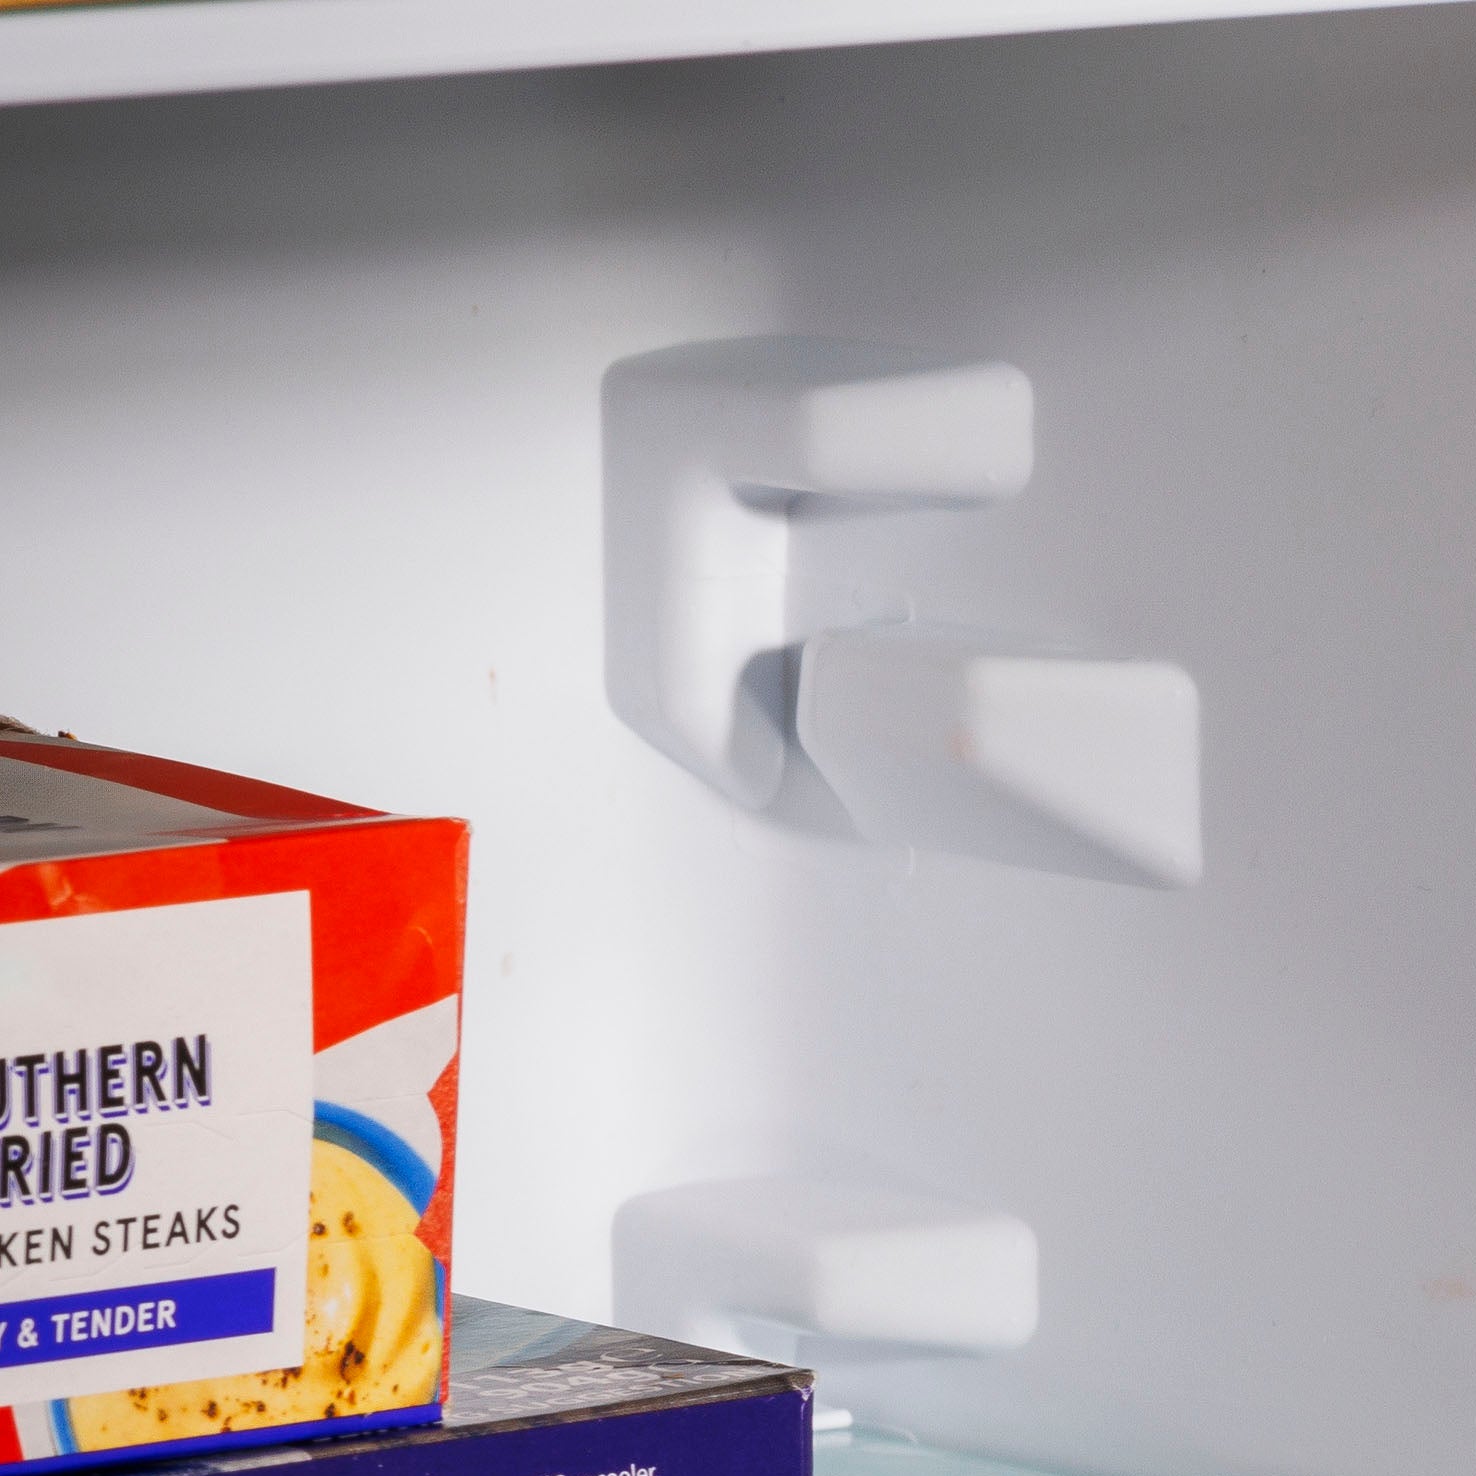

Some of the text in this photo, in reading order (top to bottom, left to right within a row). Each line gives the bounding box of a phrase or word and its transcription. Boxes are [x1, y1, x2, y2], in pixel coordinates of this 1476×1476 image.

[0, 1034, 212, 1131] THERN
[0, 1123, 136, 1208] RIED
[92, 1204, 240, 1256] STEAKS
[17, 1300, 176, 1348] & TENDER
[486, 1366, 765, 1415] SUGGESTION
